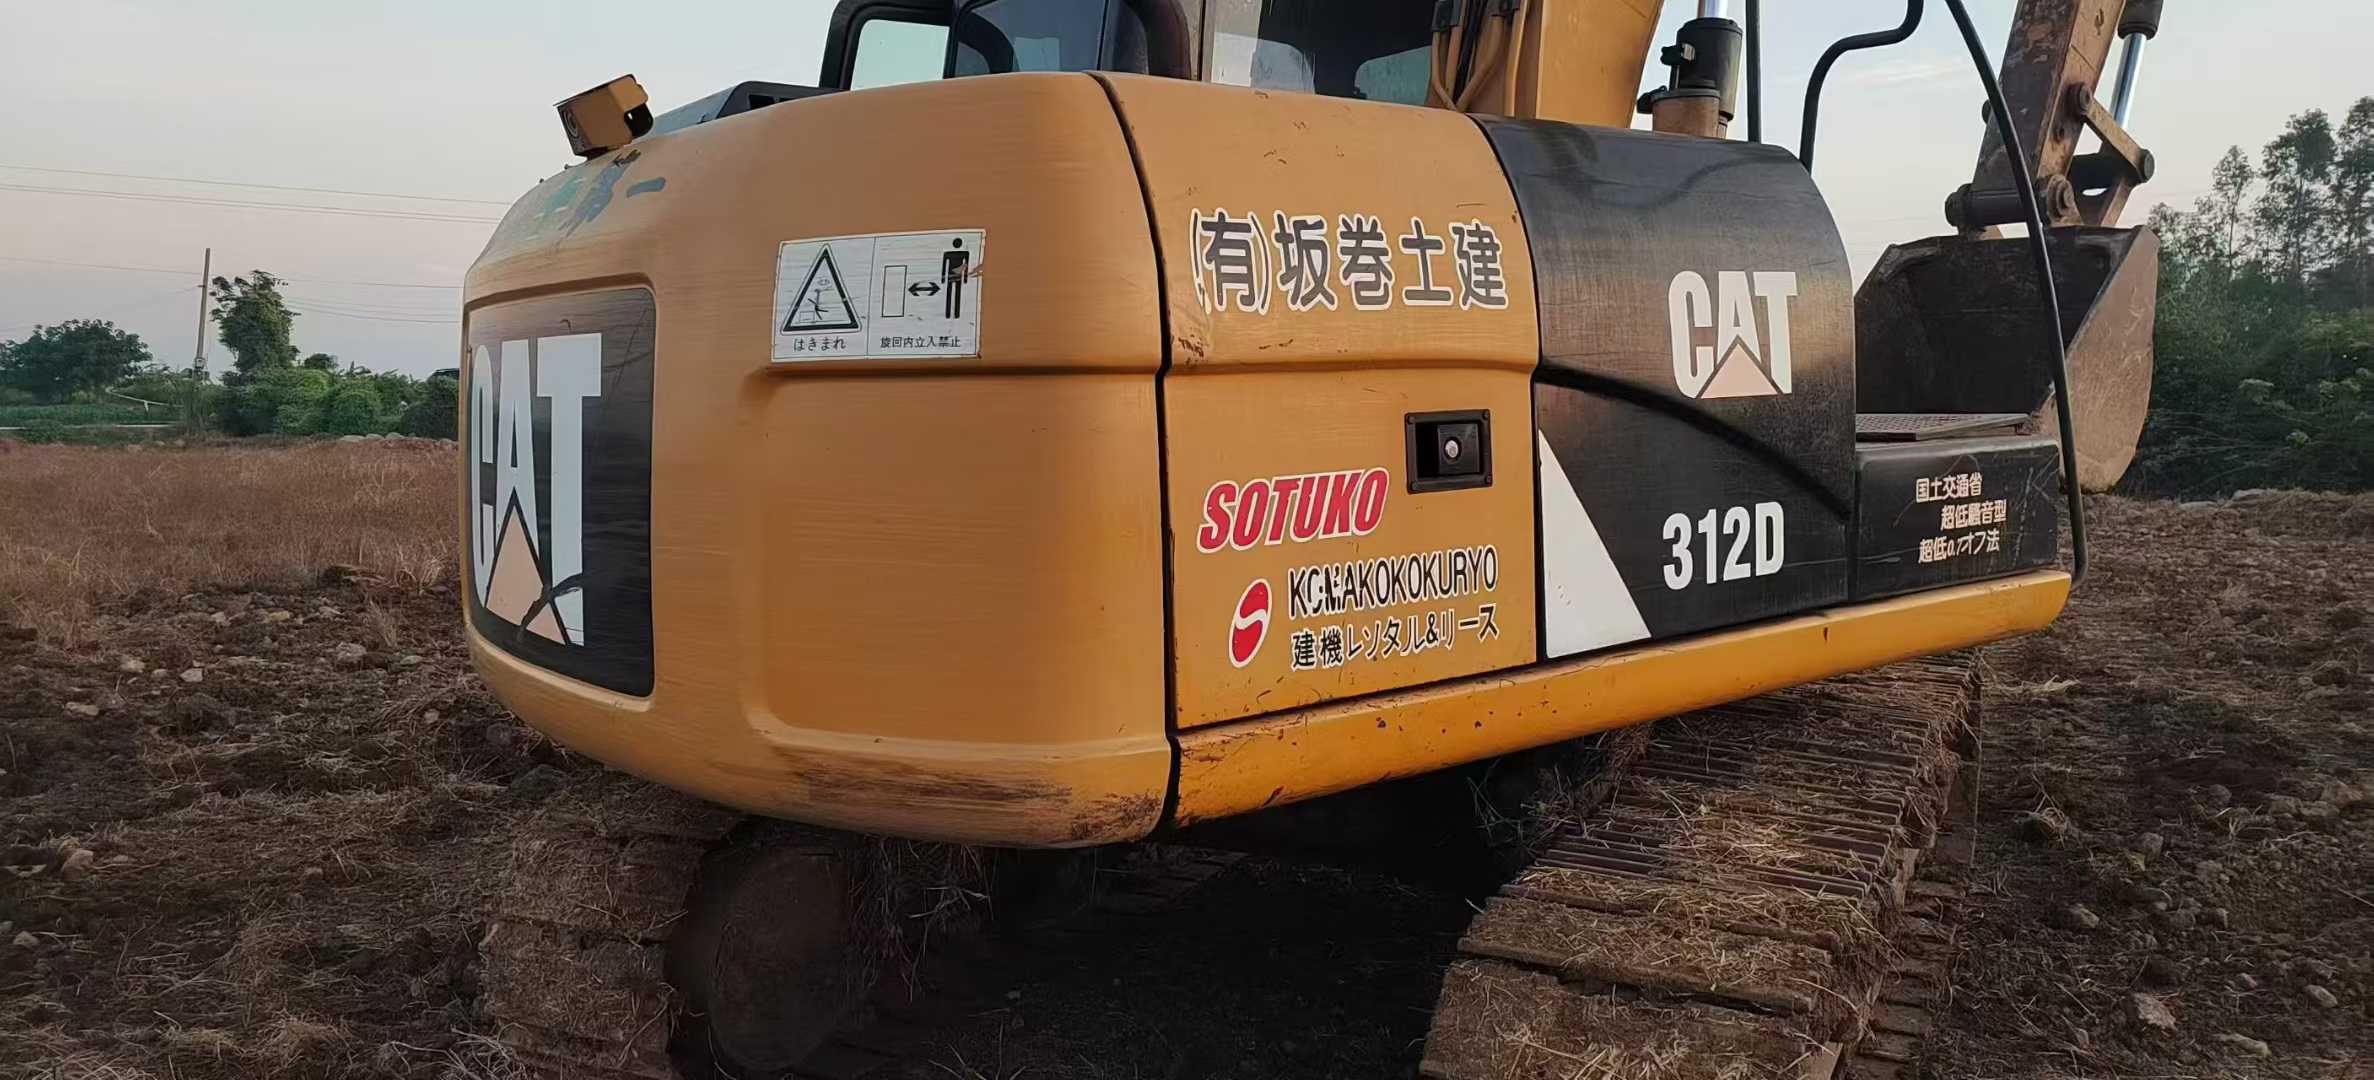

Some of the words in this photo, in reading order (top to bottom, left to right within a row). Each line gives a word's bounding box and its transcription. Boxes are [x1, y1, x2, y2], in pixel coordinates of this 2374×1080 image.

[1668, 271, 1798, 399] CAT
[471, 333, 602, 647] CAT
[1197, 467, 1389, 553] SOTUKO
[1916, 472, 1983, 503] 国土交通省
[1662, 501, 1785, 591] 312D
